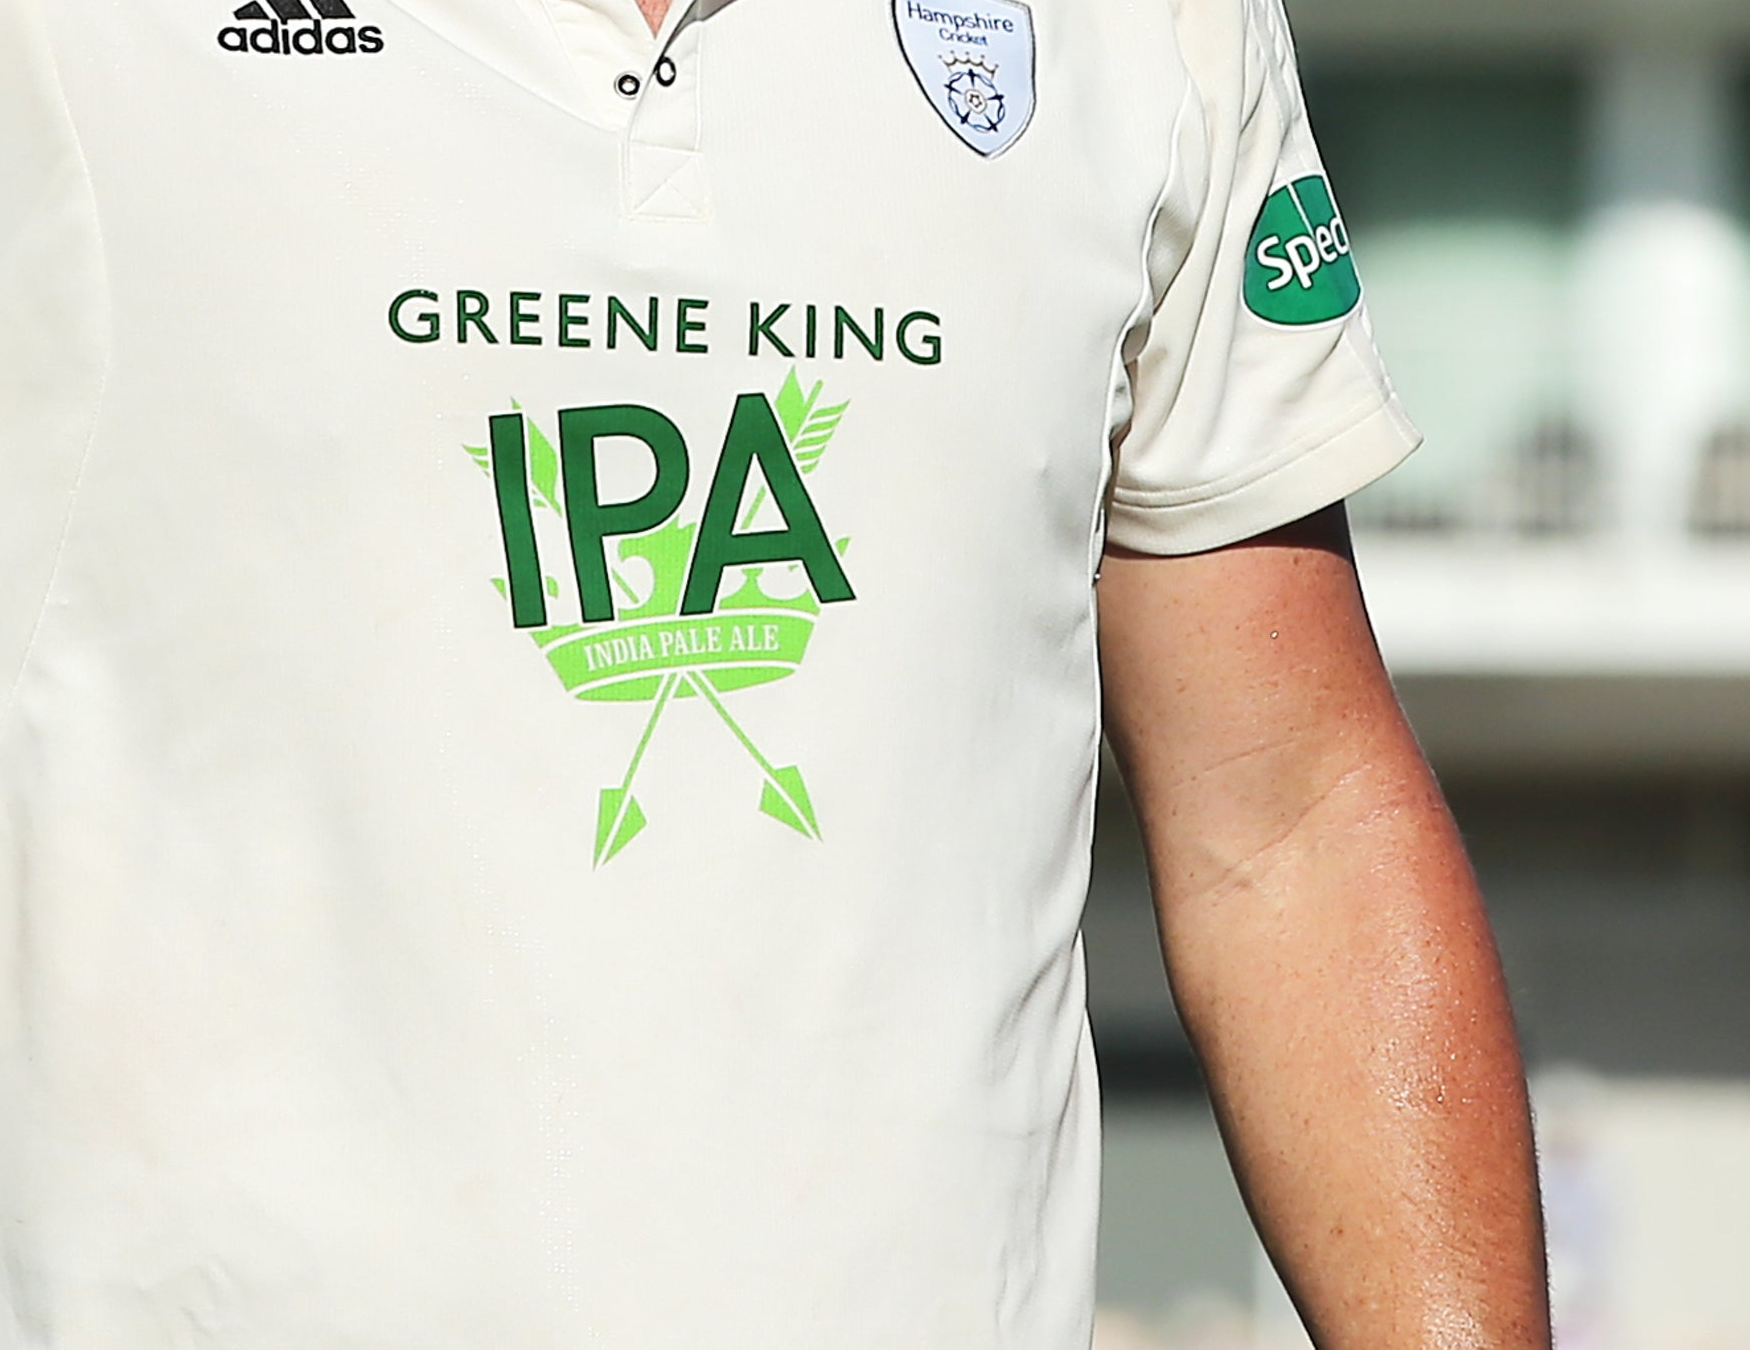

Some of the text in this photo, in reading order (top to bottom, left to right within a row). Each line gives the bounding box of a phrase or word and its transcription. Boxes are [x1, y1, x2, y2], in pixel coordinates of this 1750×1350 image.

[217, 18, 385, 55] adidas
[907, 0, 1015, 33] Hampshire
[938, 28, 989, 47] Cricket
[388, 289, 943, 365] GREENE KING
[488, 392, 858, 629] IPA
[583, 624, 779, 671] INDIA PALE ALE
